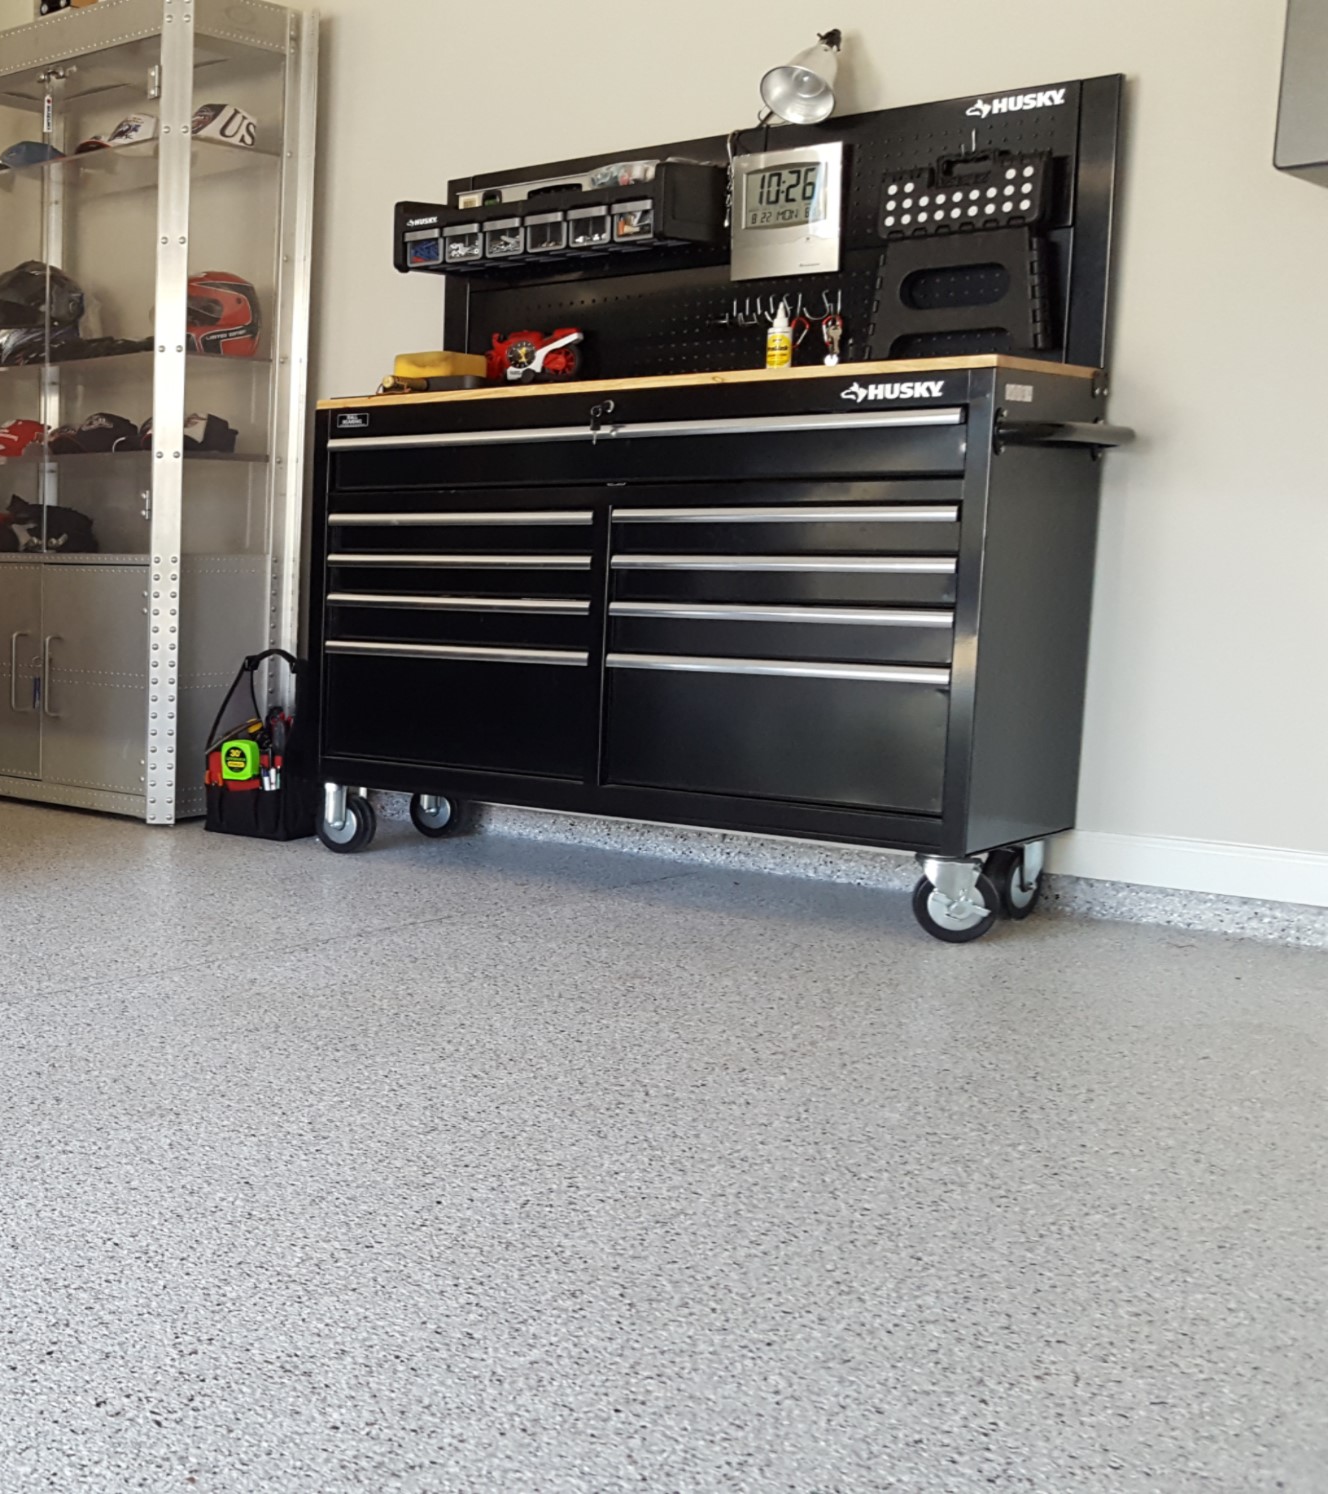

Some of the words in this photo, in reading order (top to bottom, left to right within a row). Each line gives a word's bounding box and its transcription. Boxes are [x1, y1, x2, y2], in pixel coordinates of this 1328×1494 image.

[992, 88, 1066, 115] HUSKY
[219, 107, 257, 147] US
[758, 167, 816, 205] 10:26
[414, 216, 438, 226] HUSKY
[760, 211, 772, 223] 22
[776, 208, 799, 221] MON
[867, 380, 945, 400] HUSKY
